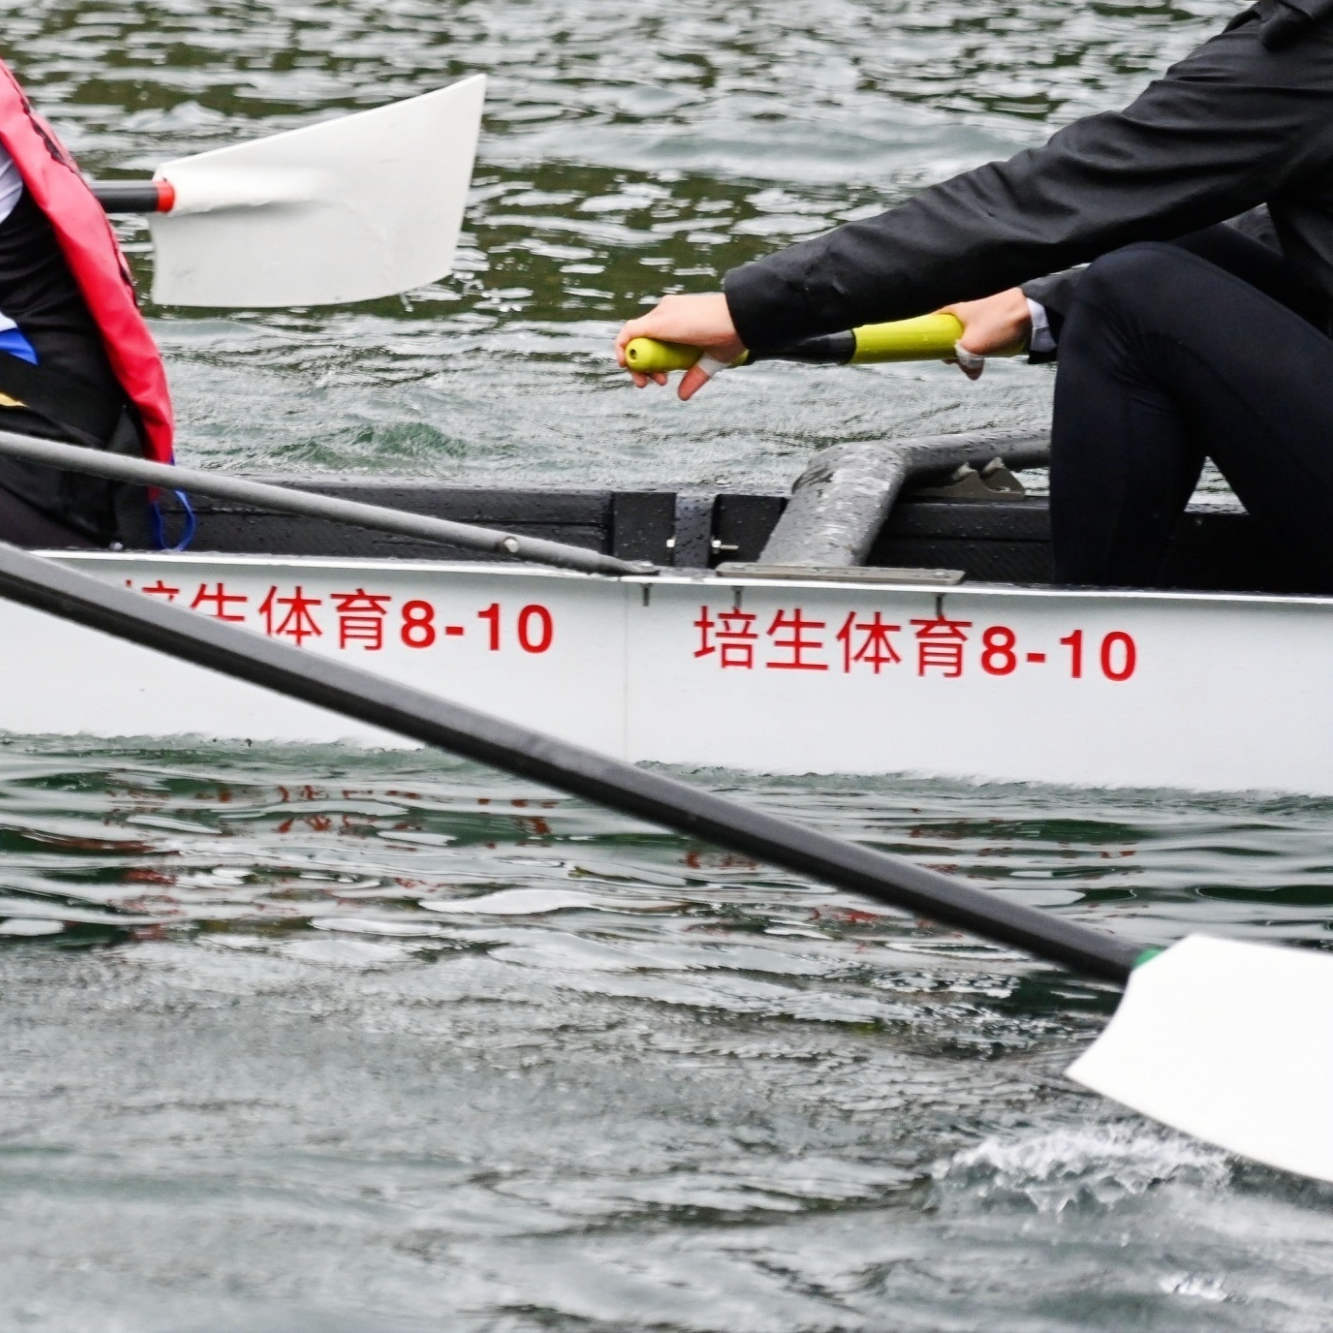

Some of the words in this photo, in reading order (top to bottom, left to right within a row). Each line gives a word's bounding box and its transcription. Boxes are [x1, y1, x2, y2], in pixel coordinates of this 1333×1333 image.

[125, 579, 554, 654] 生体育8-10
[694, 607, 1138, 683] 培生体育8-10
